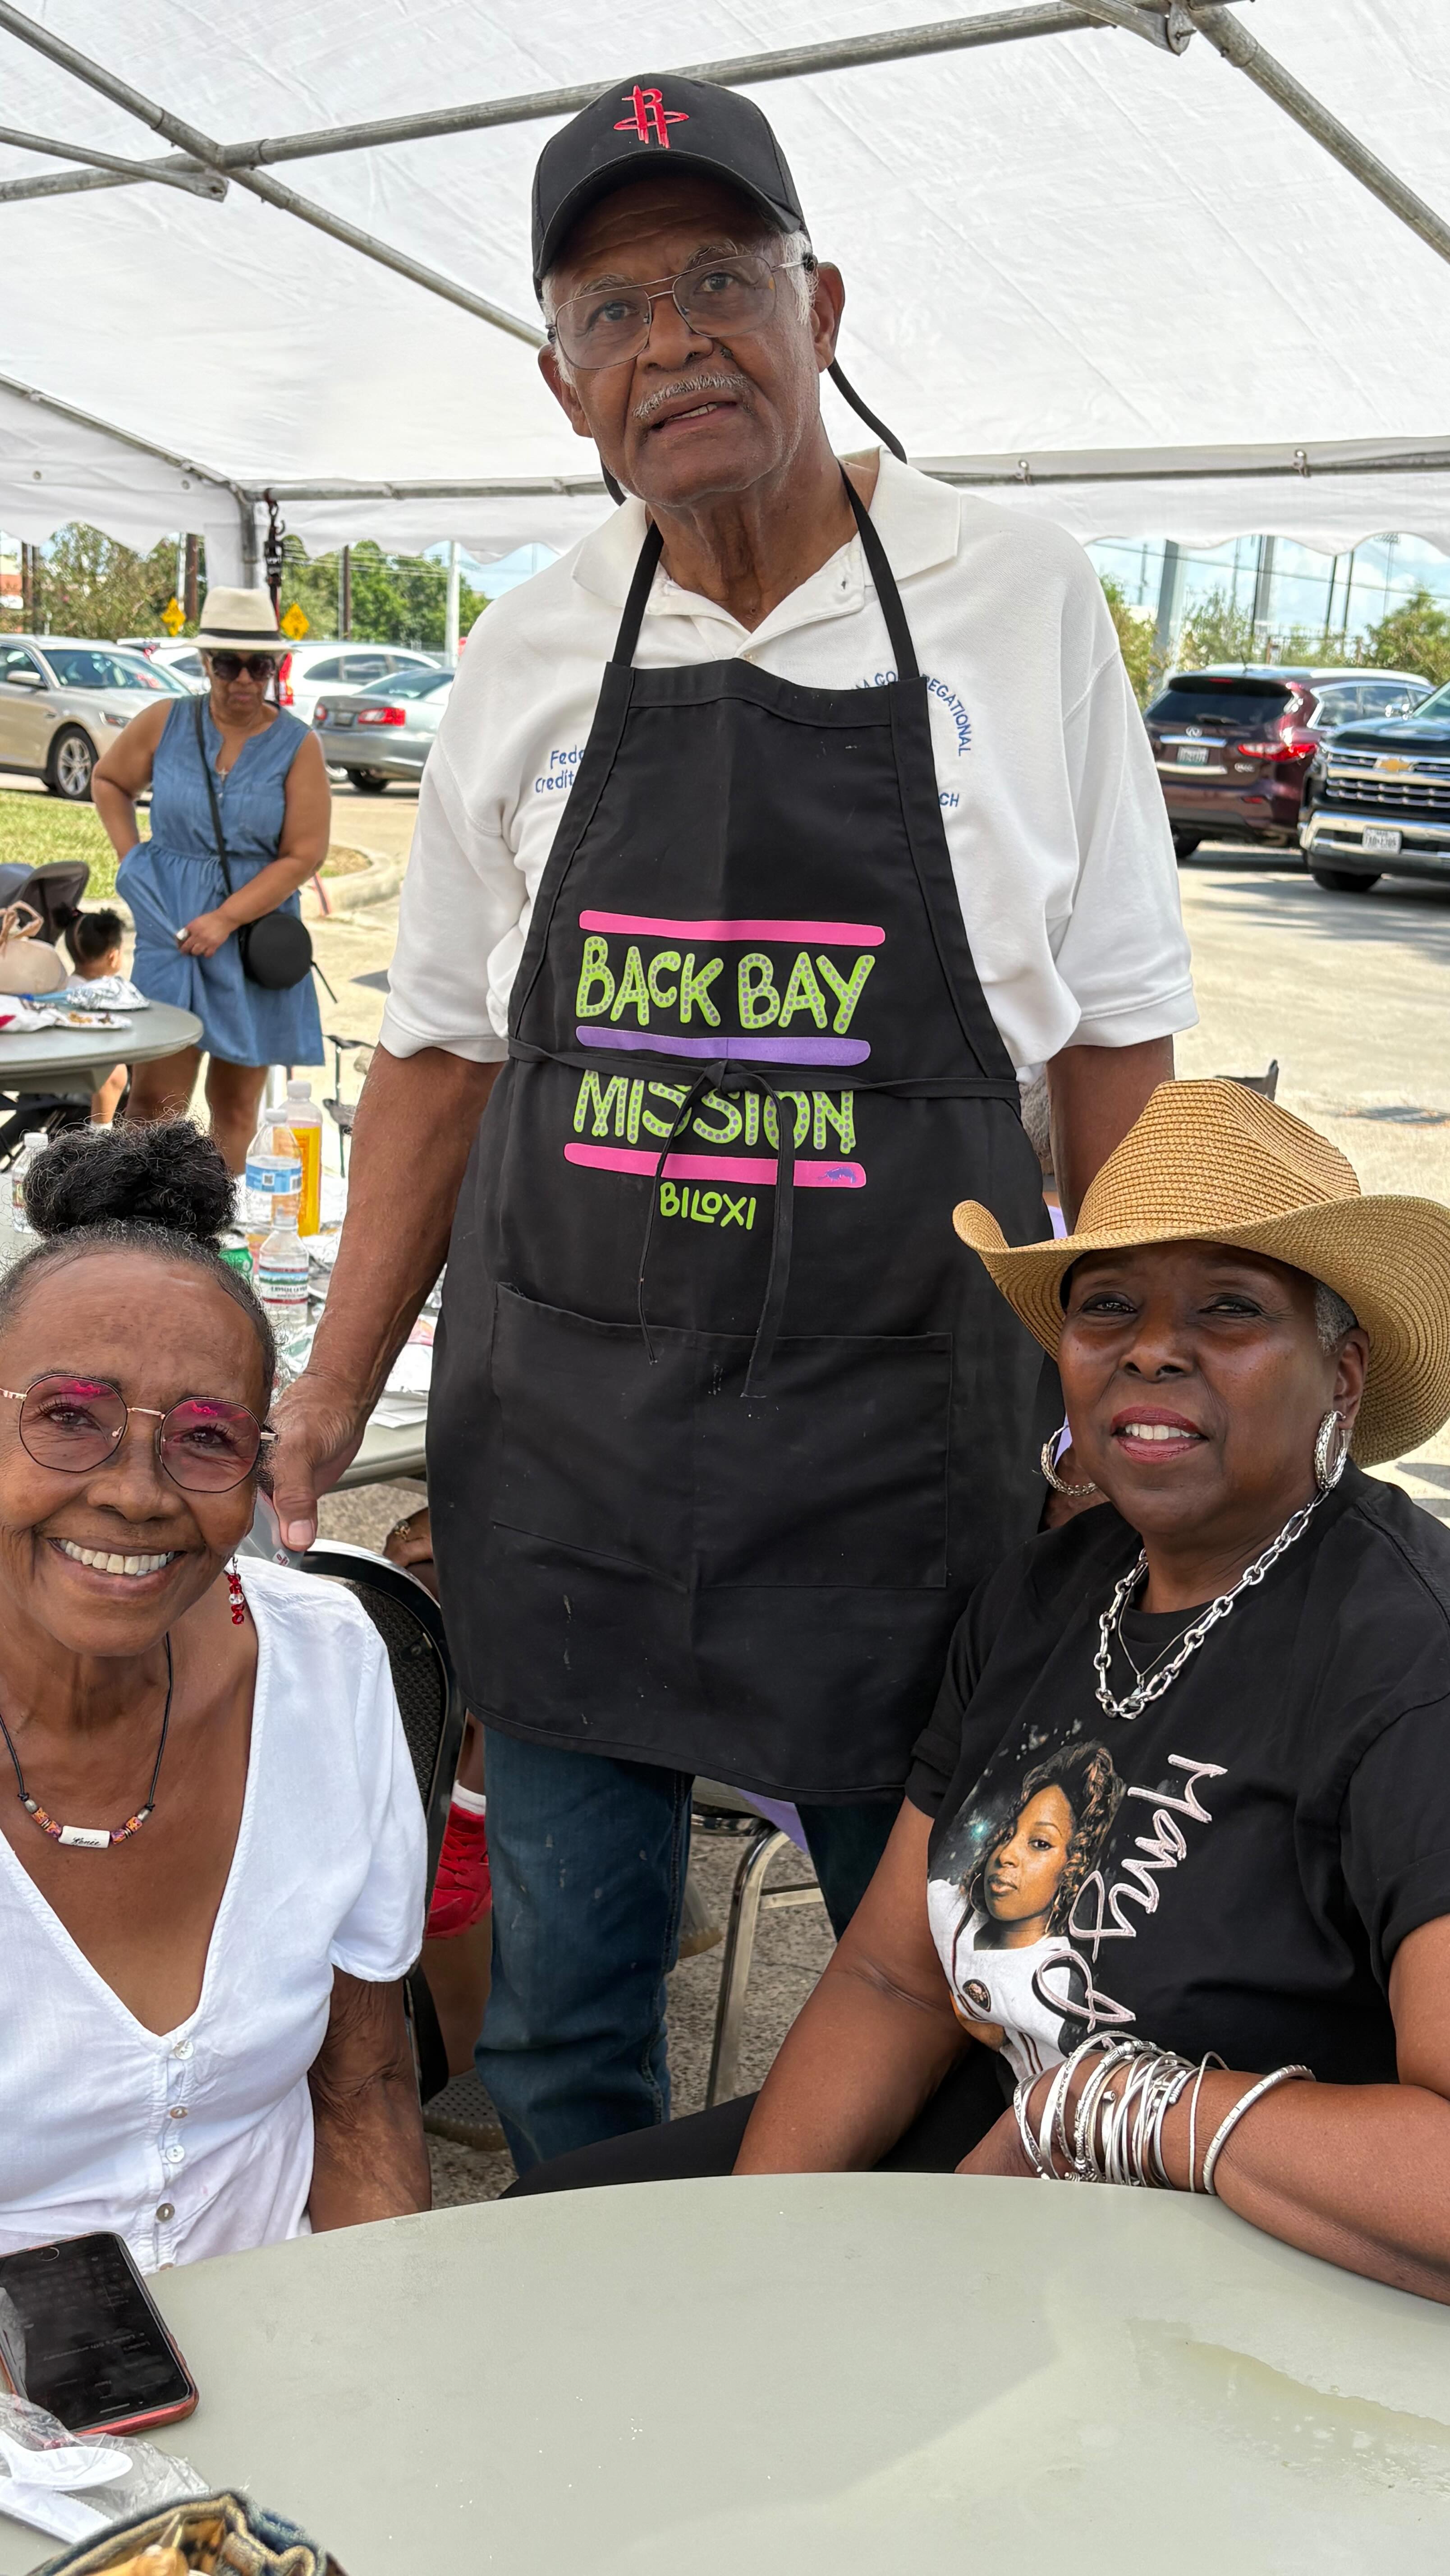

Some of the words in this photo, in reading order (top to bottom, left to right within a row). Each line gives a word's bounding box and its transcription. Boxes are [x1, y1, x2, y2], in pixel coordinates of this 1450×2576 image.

[874, 671, 972, 757] COEGATIONAL
[535, 769, 574, 793] Credit
[576, 936, 724, 1026] BACK
[738, 952, 876, 1034] BAY
[573, 1069, 856, 1154] MISSION
[660, 1182, 756, 1230] BILOXI
[1068, 1754, 1228, 1964] Mary
